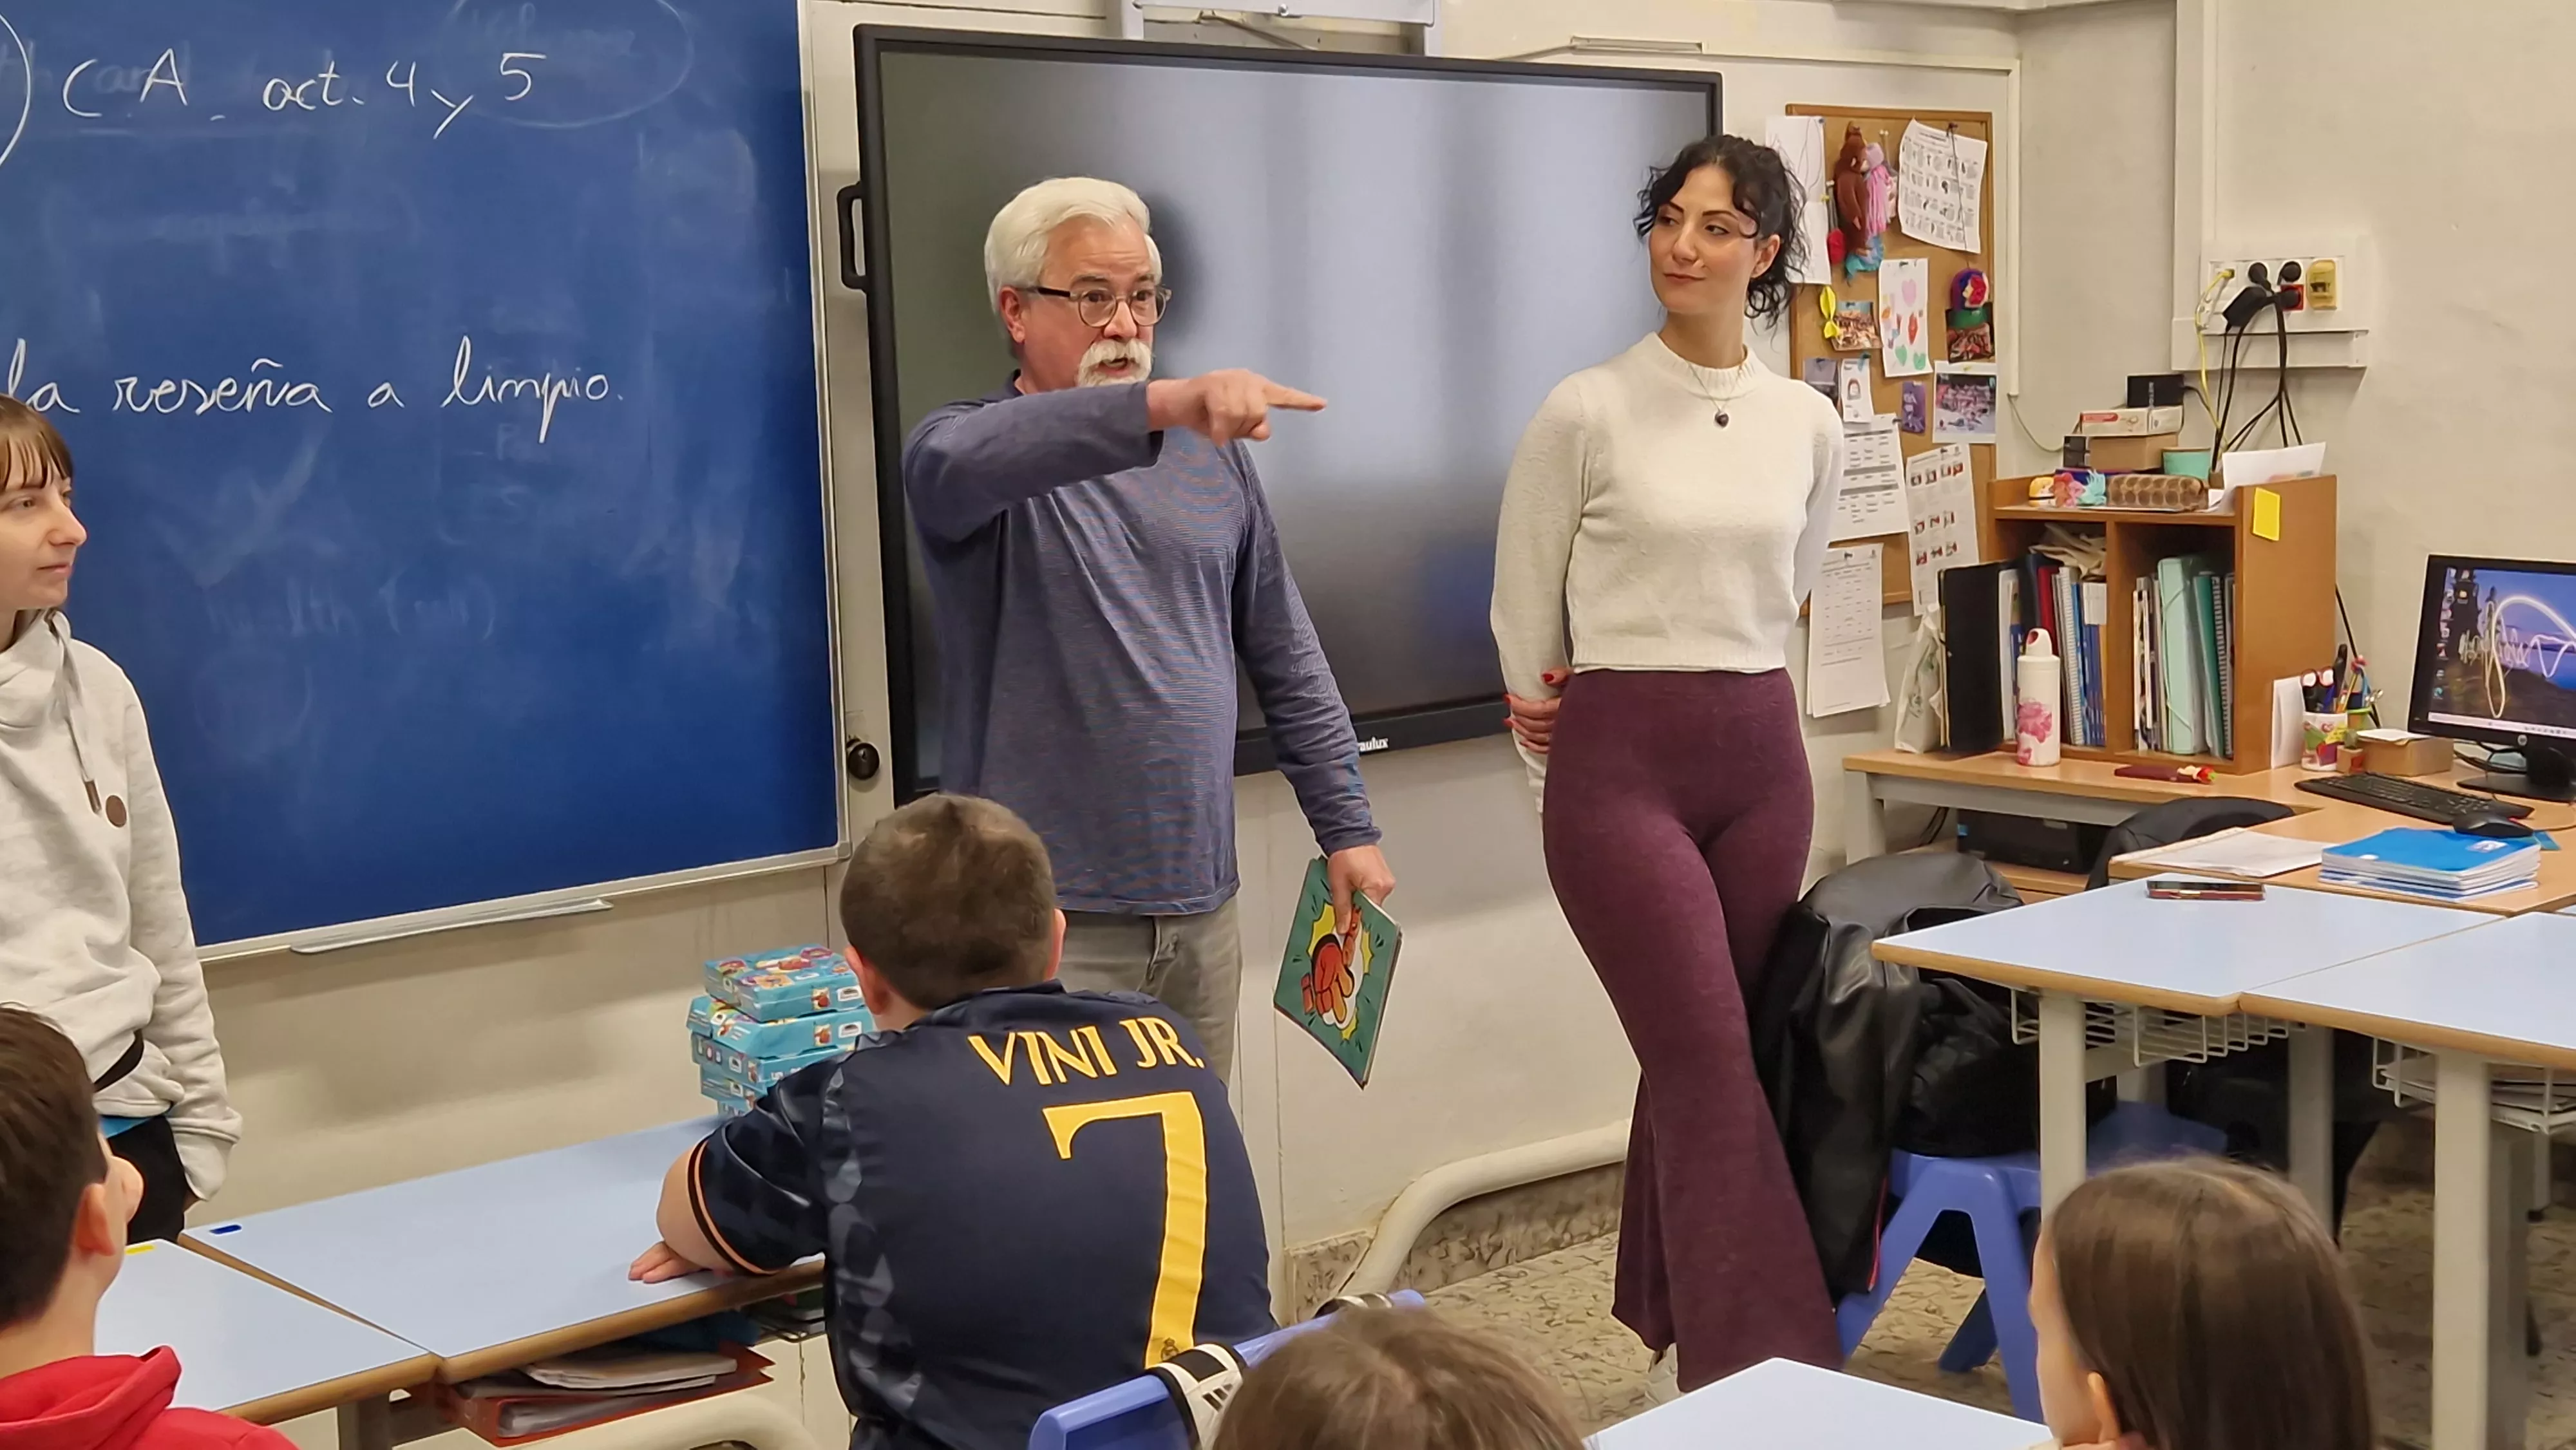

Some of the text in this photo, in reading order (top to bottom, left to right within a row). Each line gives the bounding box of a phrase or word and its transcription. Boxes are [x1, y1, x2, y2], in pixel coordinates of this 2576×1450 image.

[386, 61, 417, 106] 4
[431, 90, 473, 139] y
[499, 52, 546, 101] 5
[7, 337, 80, 414] la
[113, 357, 332, 415] reseña
[367, 382, 405, 411] a
[968, 1016, 1205, 1086] VINI JR.
[1042, 1091, 1206, 1370] 7
